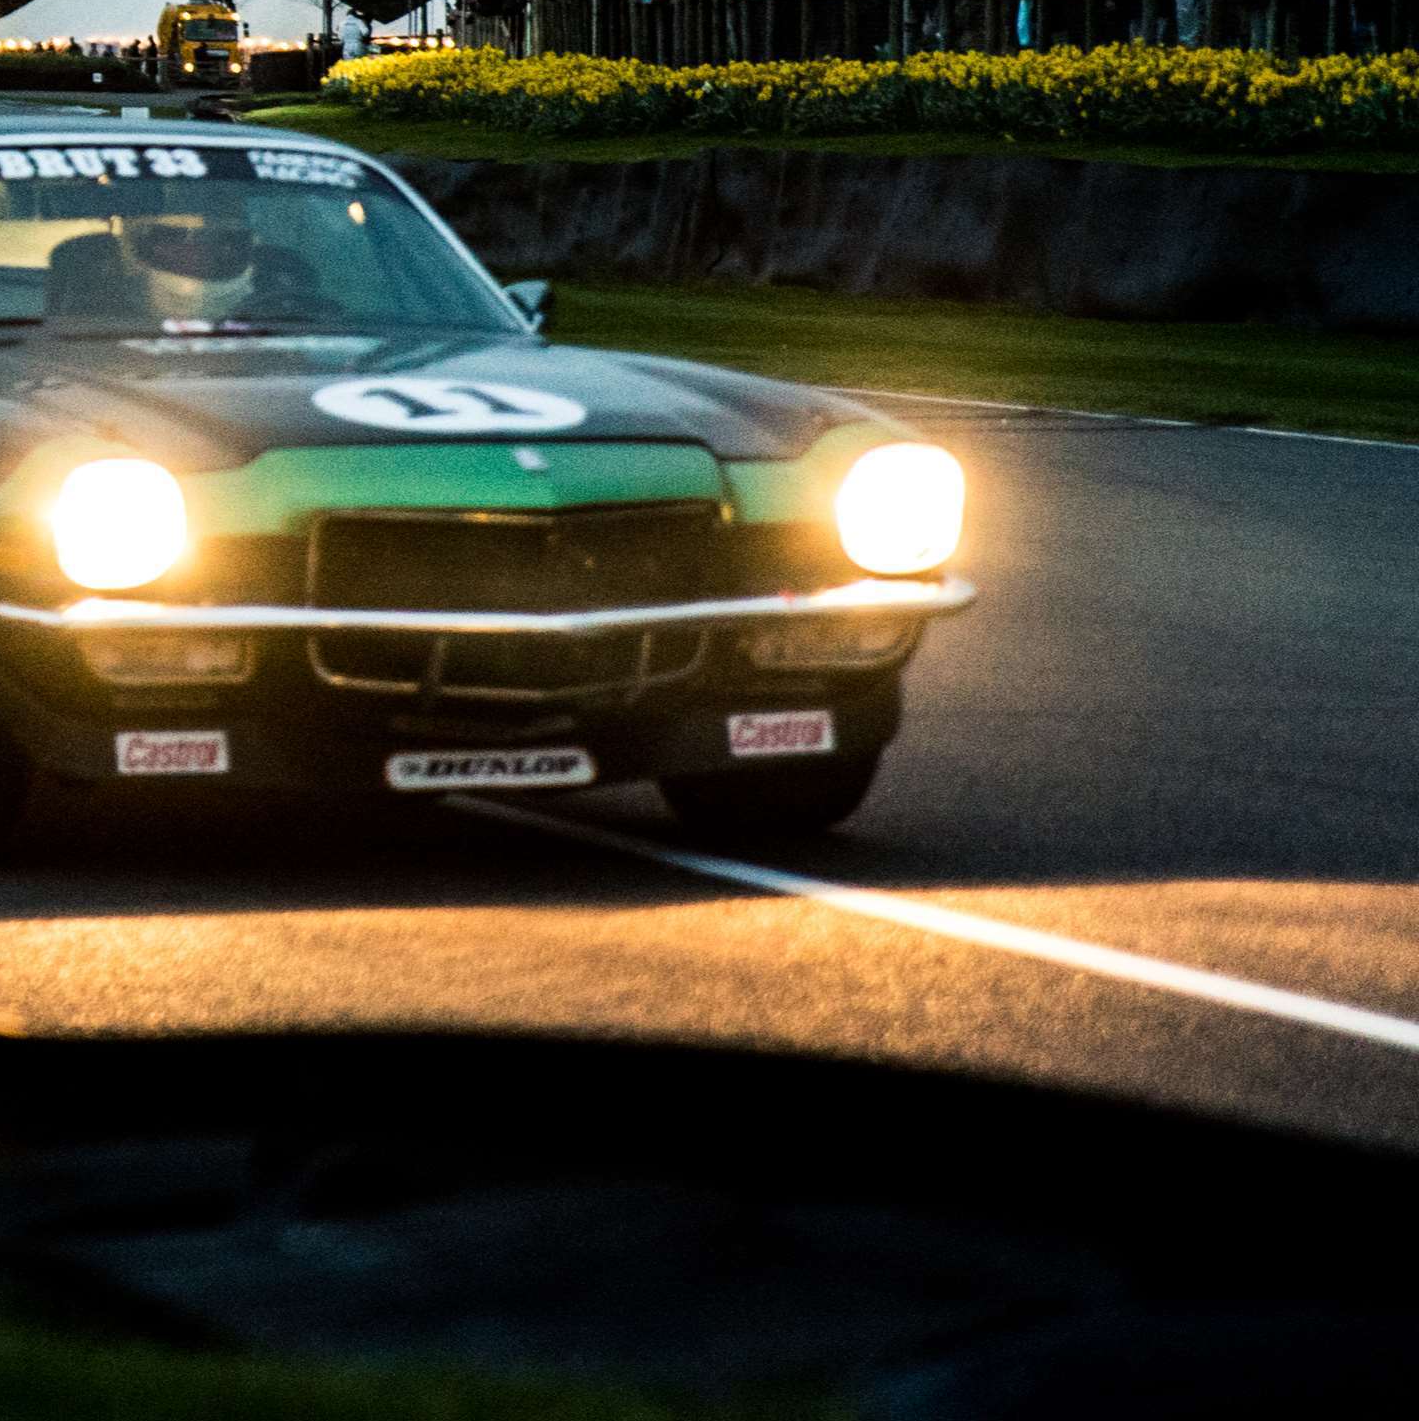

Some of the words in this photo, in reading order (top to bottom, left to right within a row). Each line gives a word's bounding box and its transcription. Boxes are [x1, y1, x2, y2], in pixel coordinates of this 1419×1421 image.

[142, 148, 209, 179] 33
[731, 720, 824, 748] Castrol
[126, 737, 218, 768] Castrol
[426, 753, 581, 777] DUNLOP
